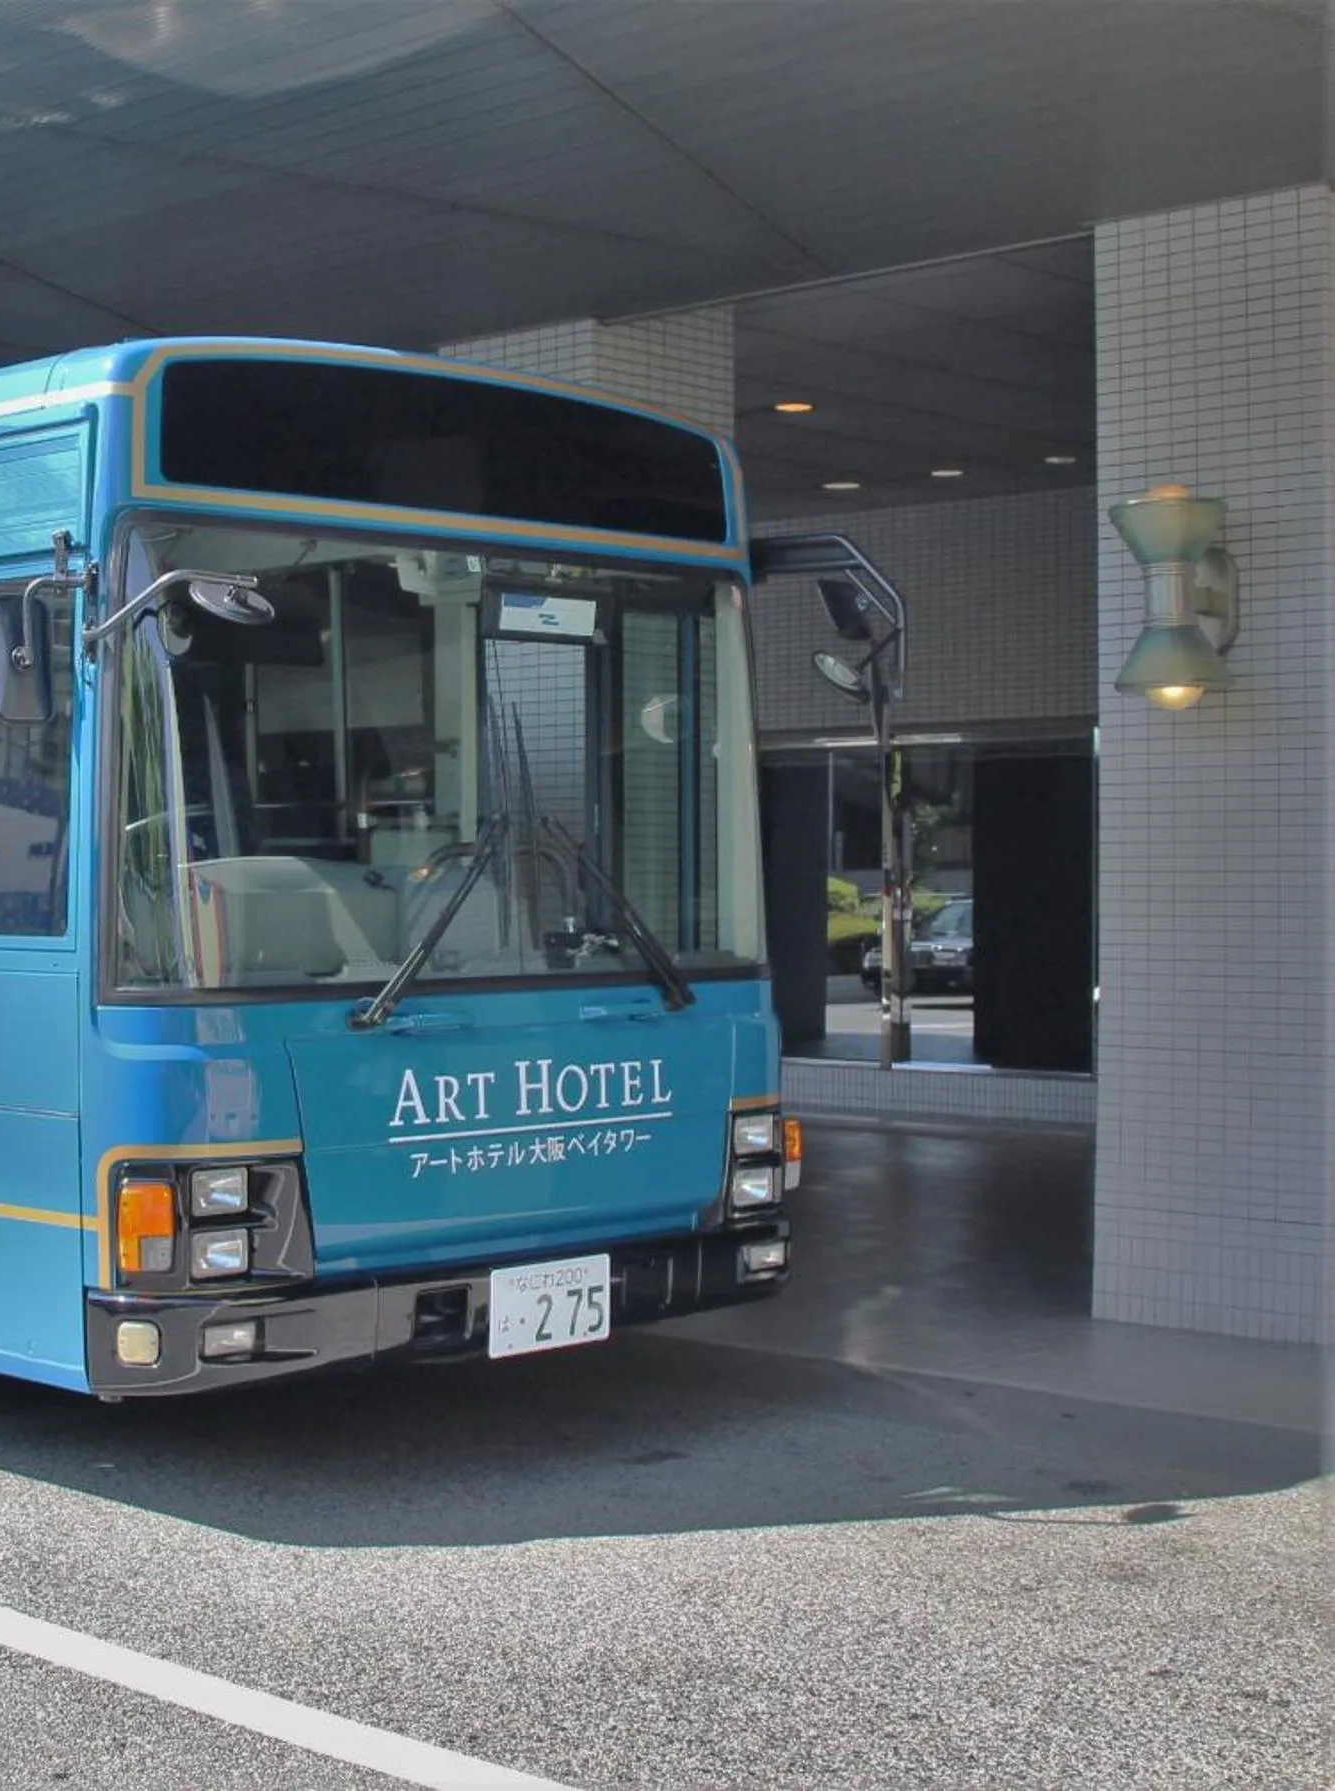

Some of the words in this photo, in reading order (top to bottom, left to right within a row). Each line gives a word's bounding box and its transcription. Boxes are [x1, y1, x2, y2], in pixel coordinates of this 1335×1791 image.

[409, 1128, 653, 1179] アートホテル大阪ベイタワー
